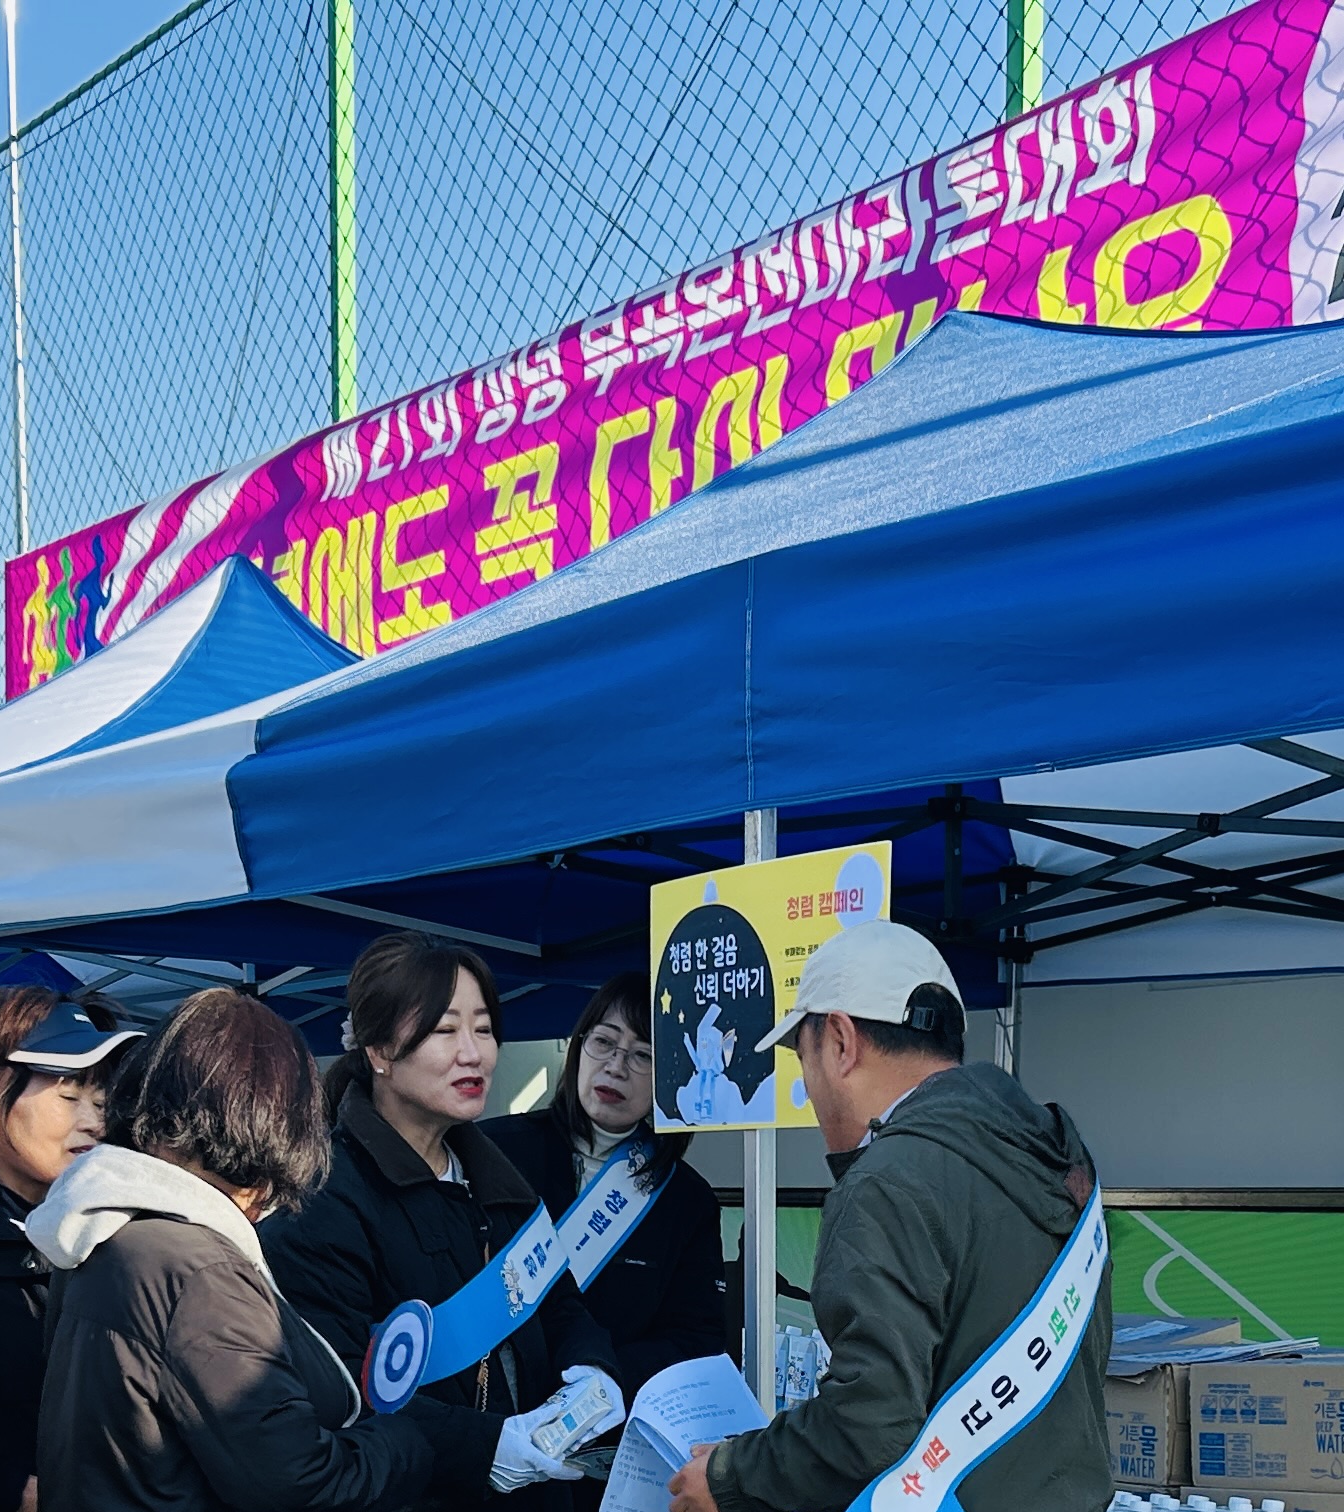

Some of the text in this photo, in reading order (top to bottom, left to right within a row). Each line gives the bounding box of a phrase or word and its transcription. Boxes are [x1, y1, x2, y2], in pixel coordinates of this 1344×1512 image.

[321, 378, 463, 502] 제21회
[471, 338, 569, 446] 창녕
[786, 887, 864, 921] 청렴 캠페인
[668, 933, 739, 975] 청렴 한 걸음
[693, 965, 765, 1006] 신뢰 더하기
[961, 1373, 1020, 1437] 아닌
[1119, 1424, 1159, 1457] 기픈물
[900, 1435, 952, 1499] 필수
[1120, 1456, 1155, 1479] WATER
